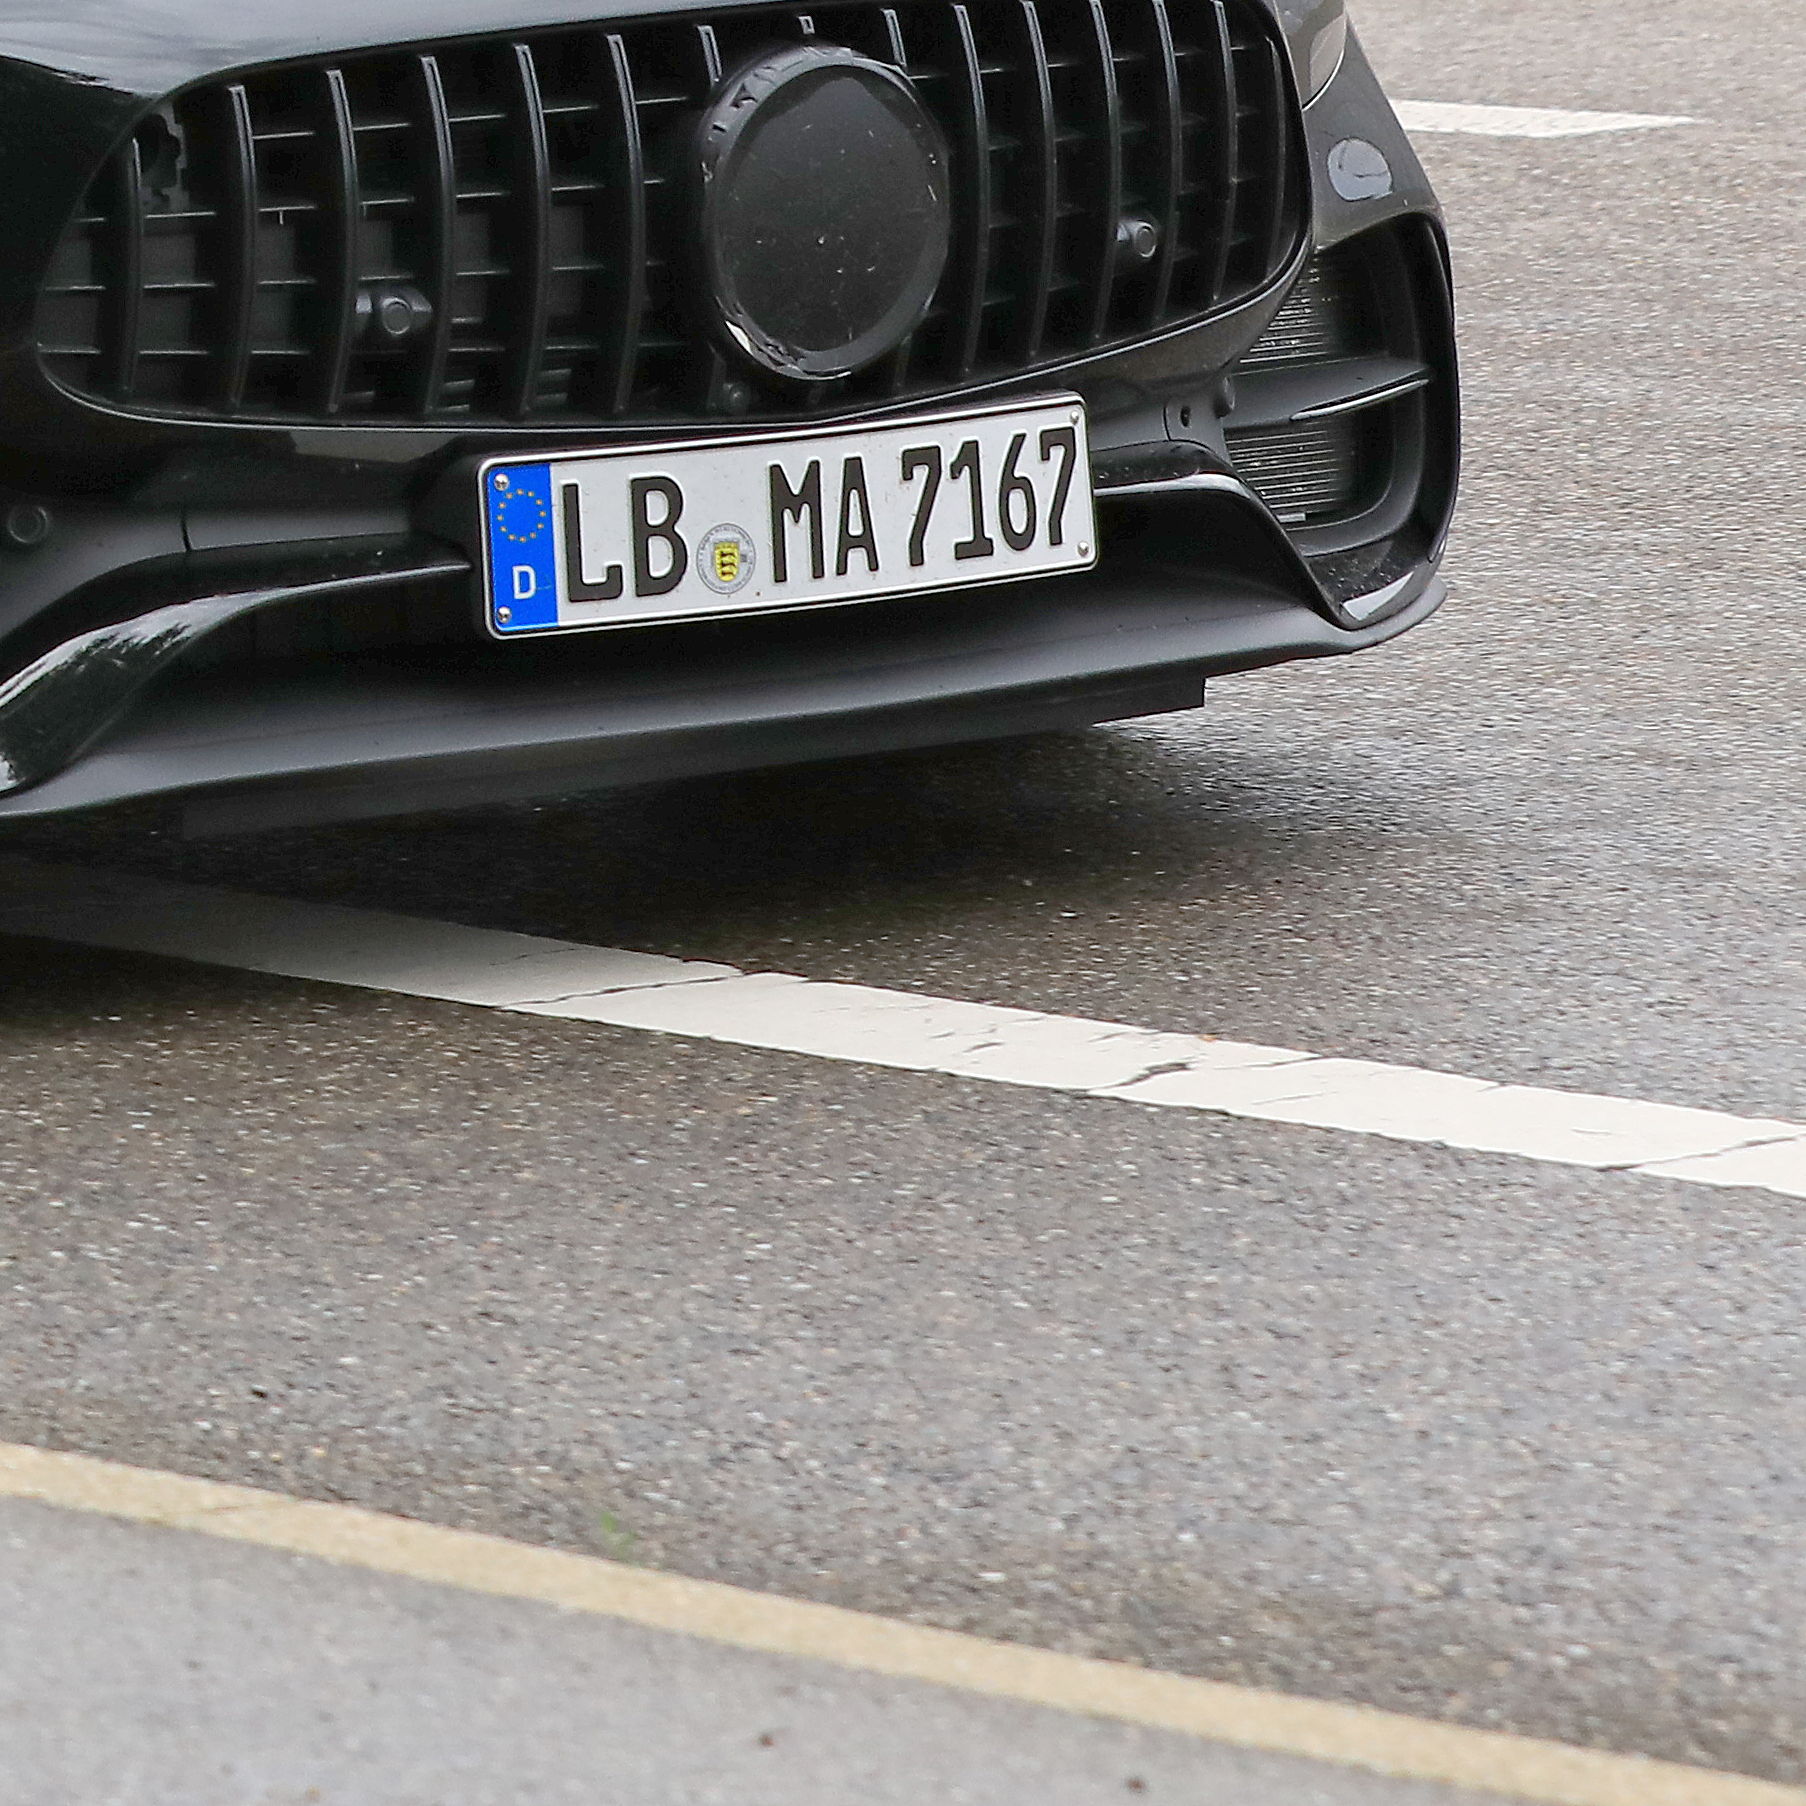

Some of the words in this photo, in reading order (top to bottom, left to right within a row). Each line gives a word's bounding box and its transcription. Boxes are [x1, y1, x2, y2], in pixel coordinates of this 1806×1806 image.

[561, 475, 689, 603] LB
[767, 455, 879, 584] MA
[901, 425, 1078, 568] 7167
[512, 565, 537, 601] D
